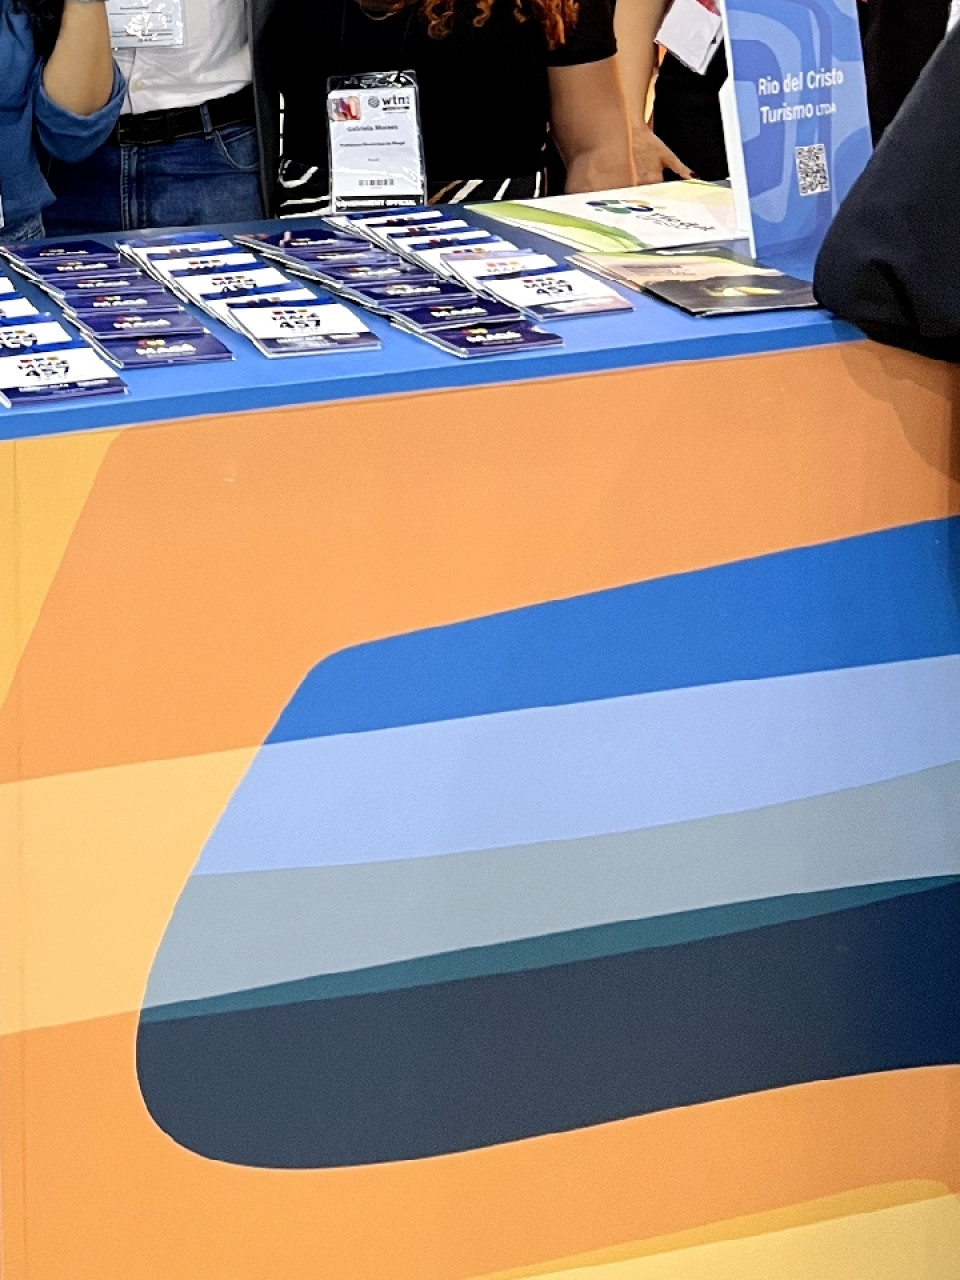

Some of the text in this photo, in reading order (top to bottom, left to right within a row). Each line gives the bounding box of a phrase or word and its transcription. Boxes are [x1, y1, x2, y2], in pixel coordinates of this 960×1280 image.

[758, 67, 844, 96] Rio del Cristo
[760, 102, 814, 124] Turismo
